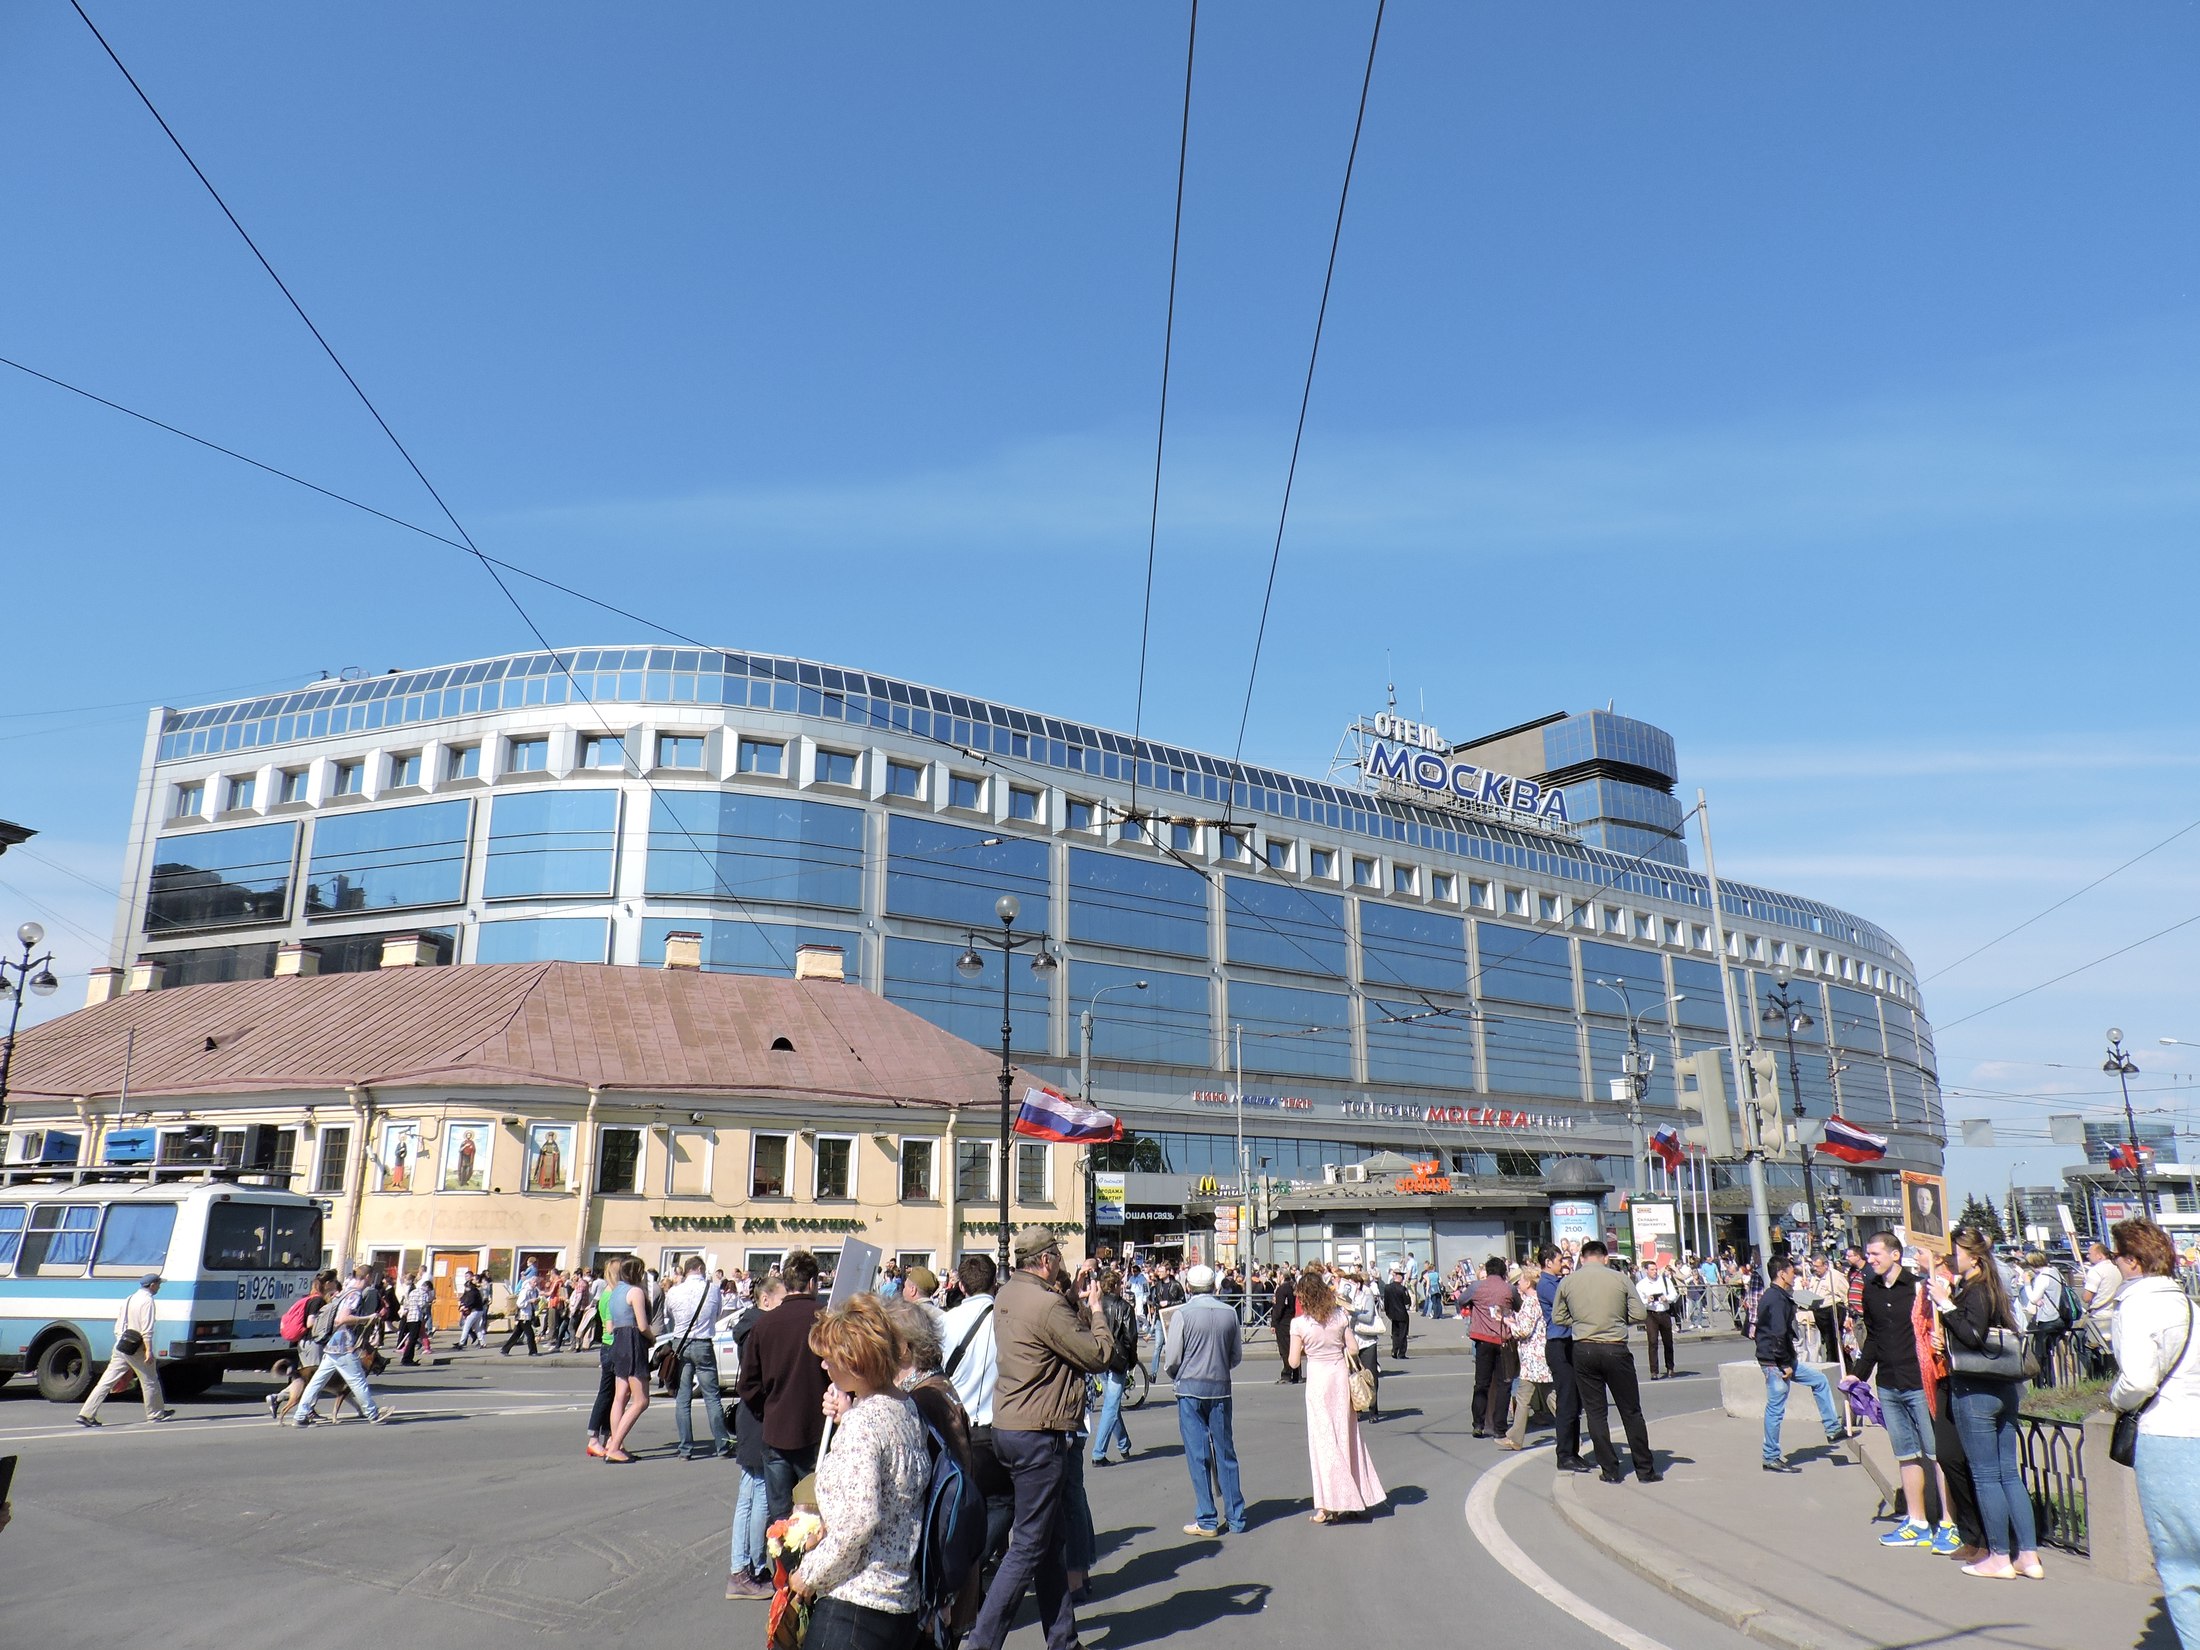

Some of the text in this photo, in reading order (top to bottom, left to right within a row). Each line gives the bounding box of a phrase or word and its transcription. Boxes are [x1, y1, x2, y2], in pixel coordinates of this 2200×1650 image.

[1374, 711, 1446, 753] ОТЕЛЬ
[1365, 740, 1569, 823] МОСКВА
[1192, 1090, 1228, 1104] КИНО
[1281, 1097, 1313, 1109] ТЕАТР
[1340, 1099, 1576, 1128] ТОРГОВЫЙ МОСКВА ЦЕНТР
[649, 1214, 733, 1229] ТОРГОВЫЙ
[742, 1217, 775, 1230] ДОМ
[251, 1276, 276, 1300] 926
[280, 1284, 294, 1299] МР
[298, 1277, 309, 1290] 78
